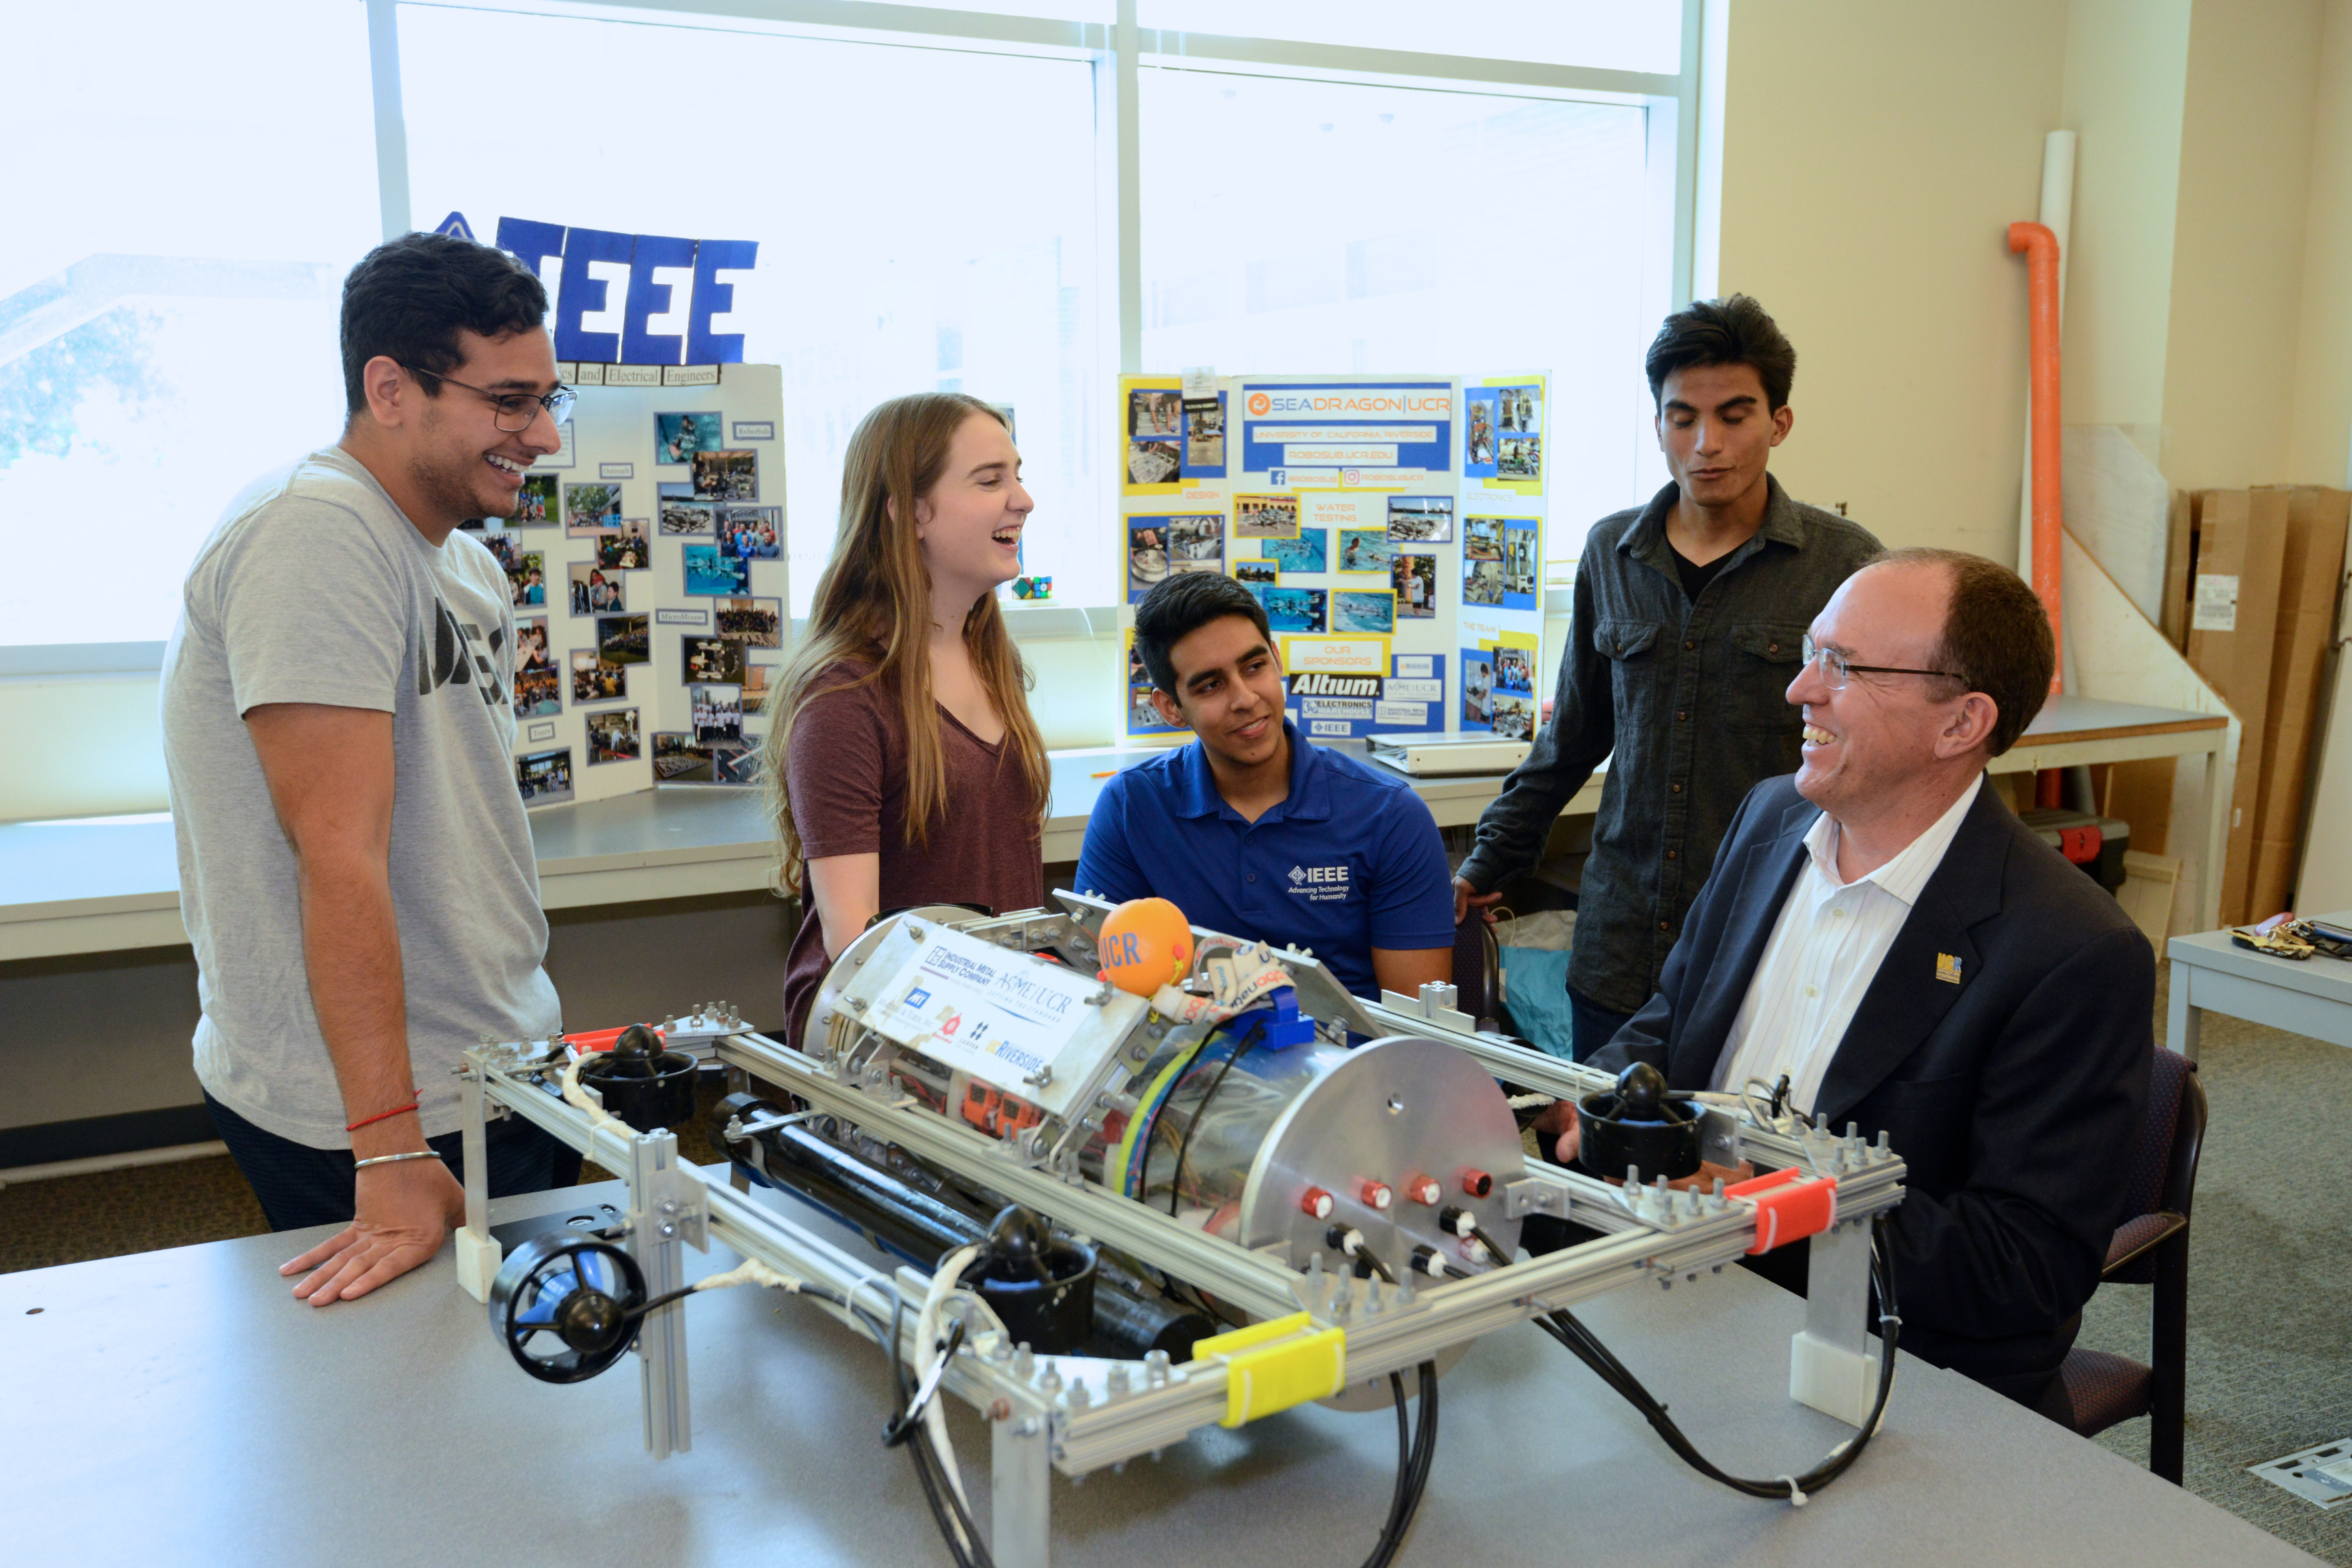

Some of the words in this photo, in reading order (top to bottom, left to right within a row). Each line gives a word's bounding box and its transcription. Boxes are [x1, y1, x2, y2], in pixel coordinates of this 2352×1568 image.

[581, 370, 601, 381] and
[609, 369, 658, 382] Electrical
[666, 370, 715, 386] Engineers
[738, 427, 770, 436] RoboSub
[1288, 451, 1394, 459] ROBOSUB.UCR.EDU
[1186, 491, 1220, 500] DESIGN
[1467, 492, 1514, 502] ELECTRONICS
[1316, 504, 1356, 512] WATER
[1313, 514, 1357, 522] TESTING
[1464, 621, 1475, 631] THE
[1477, 623, 1497, 633] TEAM
[1324, 646, 1351, 654] OUR
[1303, 657, 1372, 666] SPONSORS
[1318, 707, 1371, 715] WAREHOUSE
[1307, 866, 1349, 883] IEEE
[1288, 886, 1318, 894] Advancing
[1100, 932, 1141, 969] UCR
[945, 951, 977, 970] INDUSTRIAL
[976, 963, 997, 978] METAL
[1937, 952, 1962, 973] UCR
[938, 959, 960, 974] SUPPLY
[959, 968, 992, 986] COMPANY
